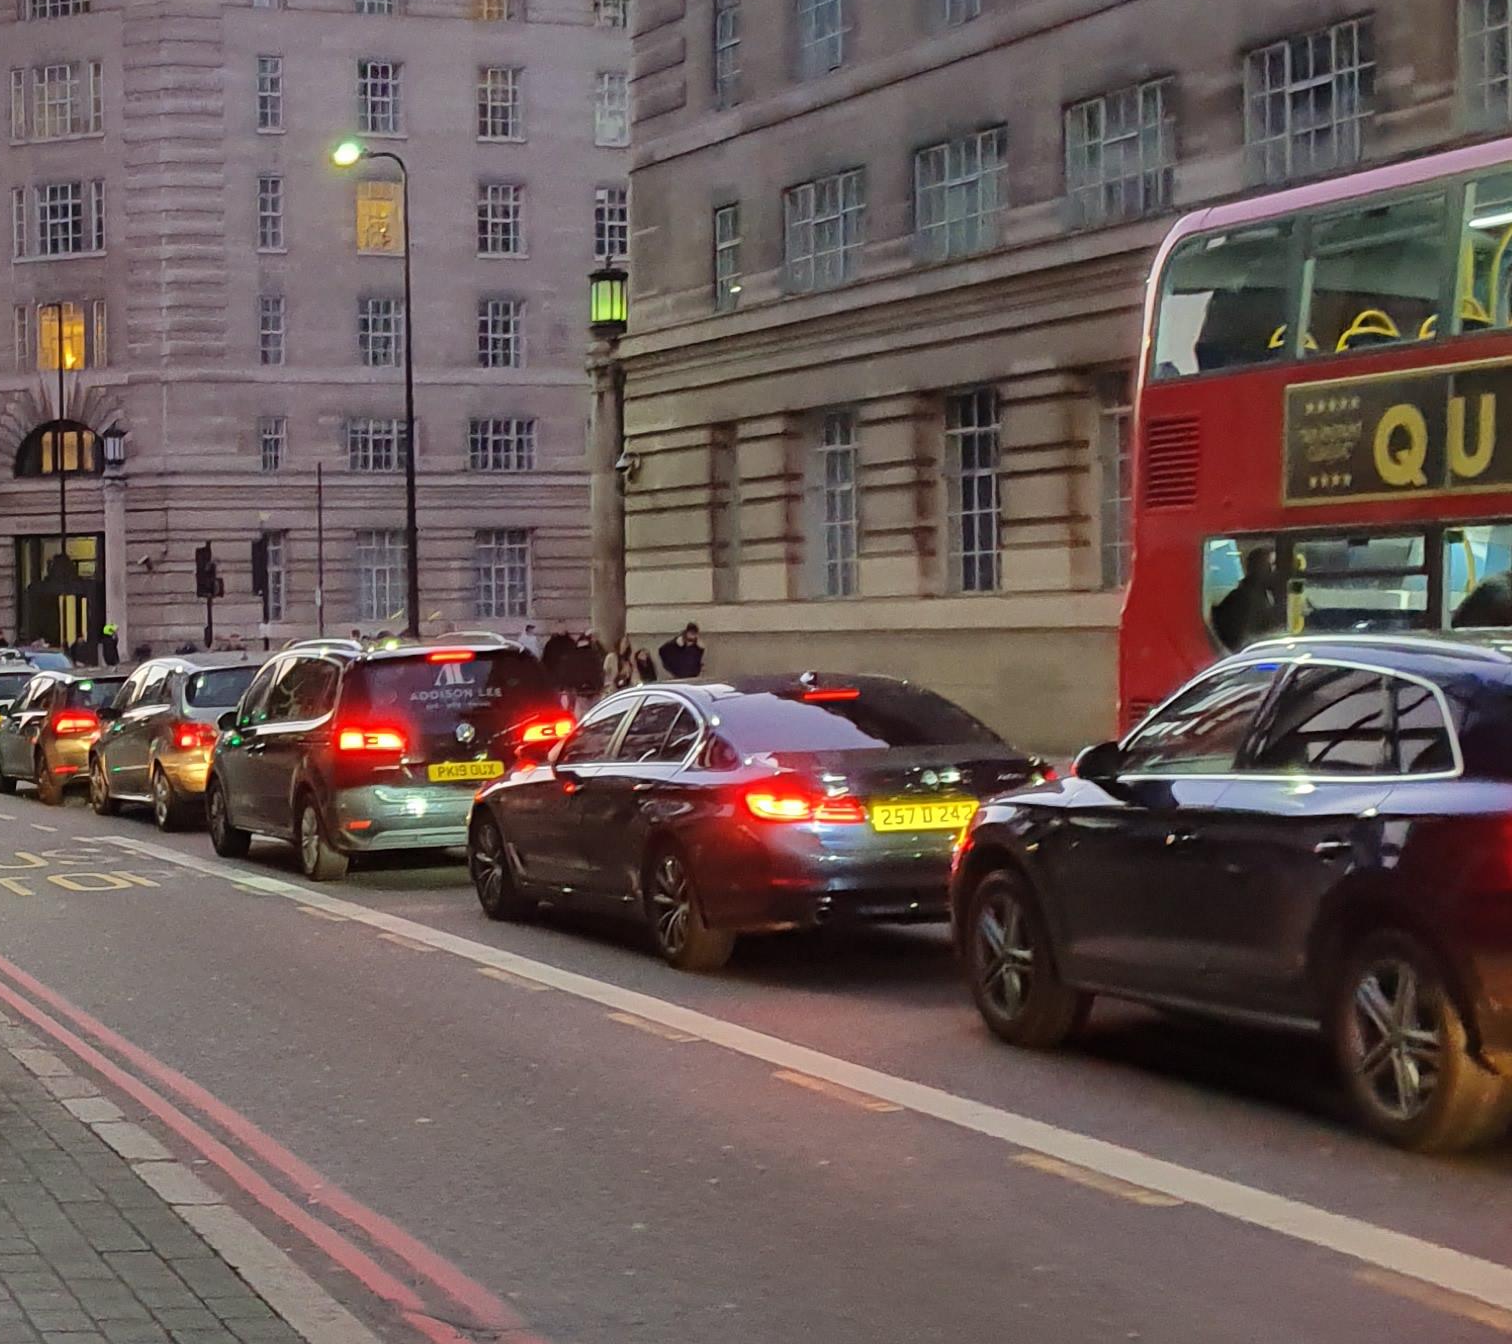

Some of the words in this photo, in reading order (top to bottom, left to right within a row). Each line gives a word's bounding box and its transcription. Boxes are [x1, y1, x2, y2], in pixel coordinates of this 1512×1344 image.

[1374, 392, 1496, 487] QU
[410, 688, 473, 702] ADDISON
[478, 687, 503, 697] LEE
[881, 807, 915, 826] 257
